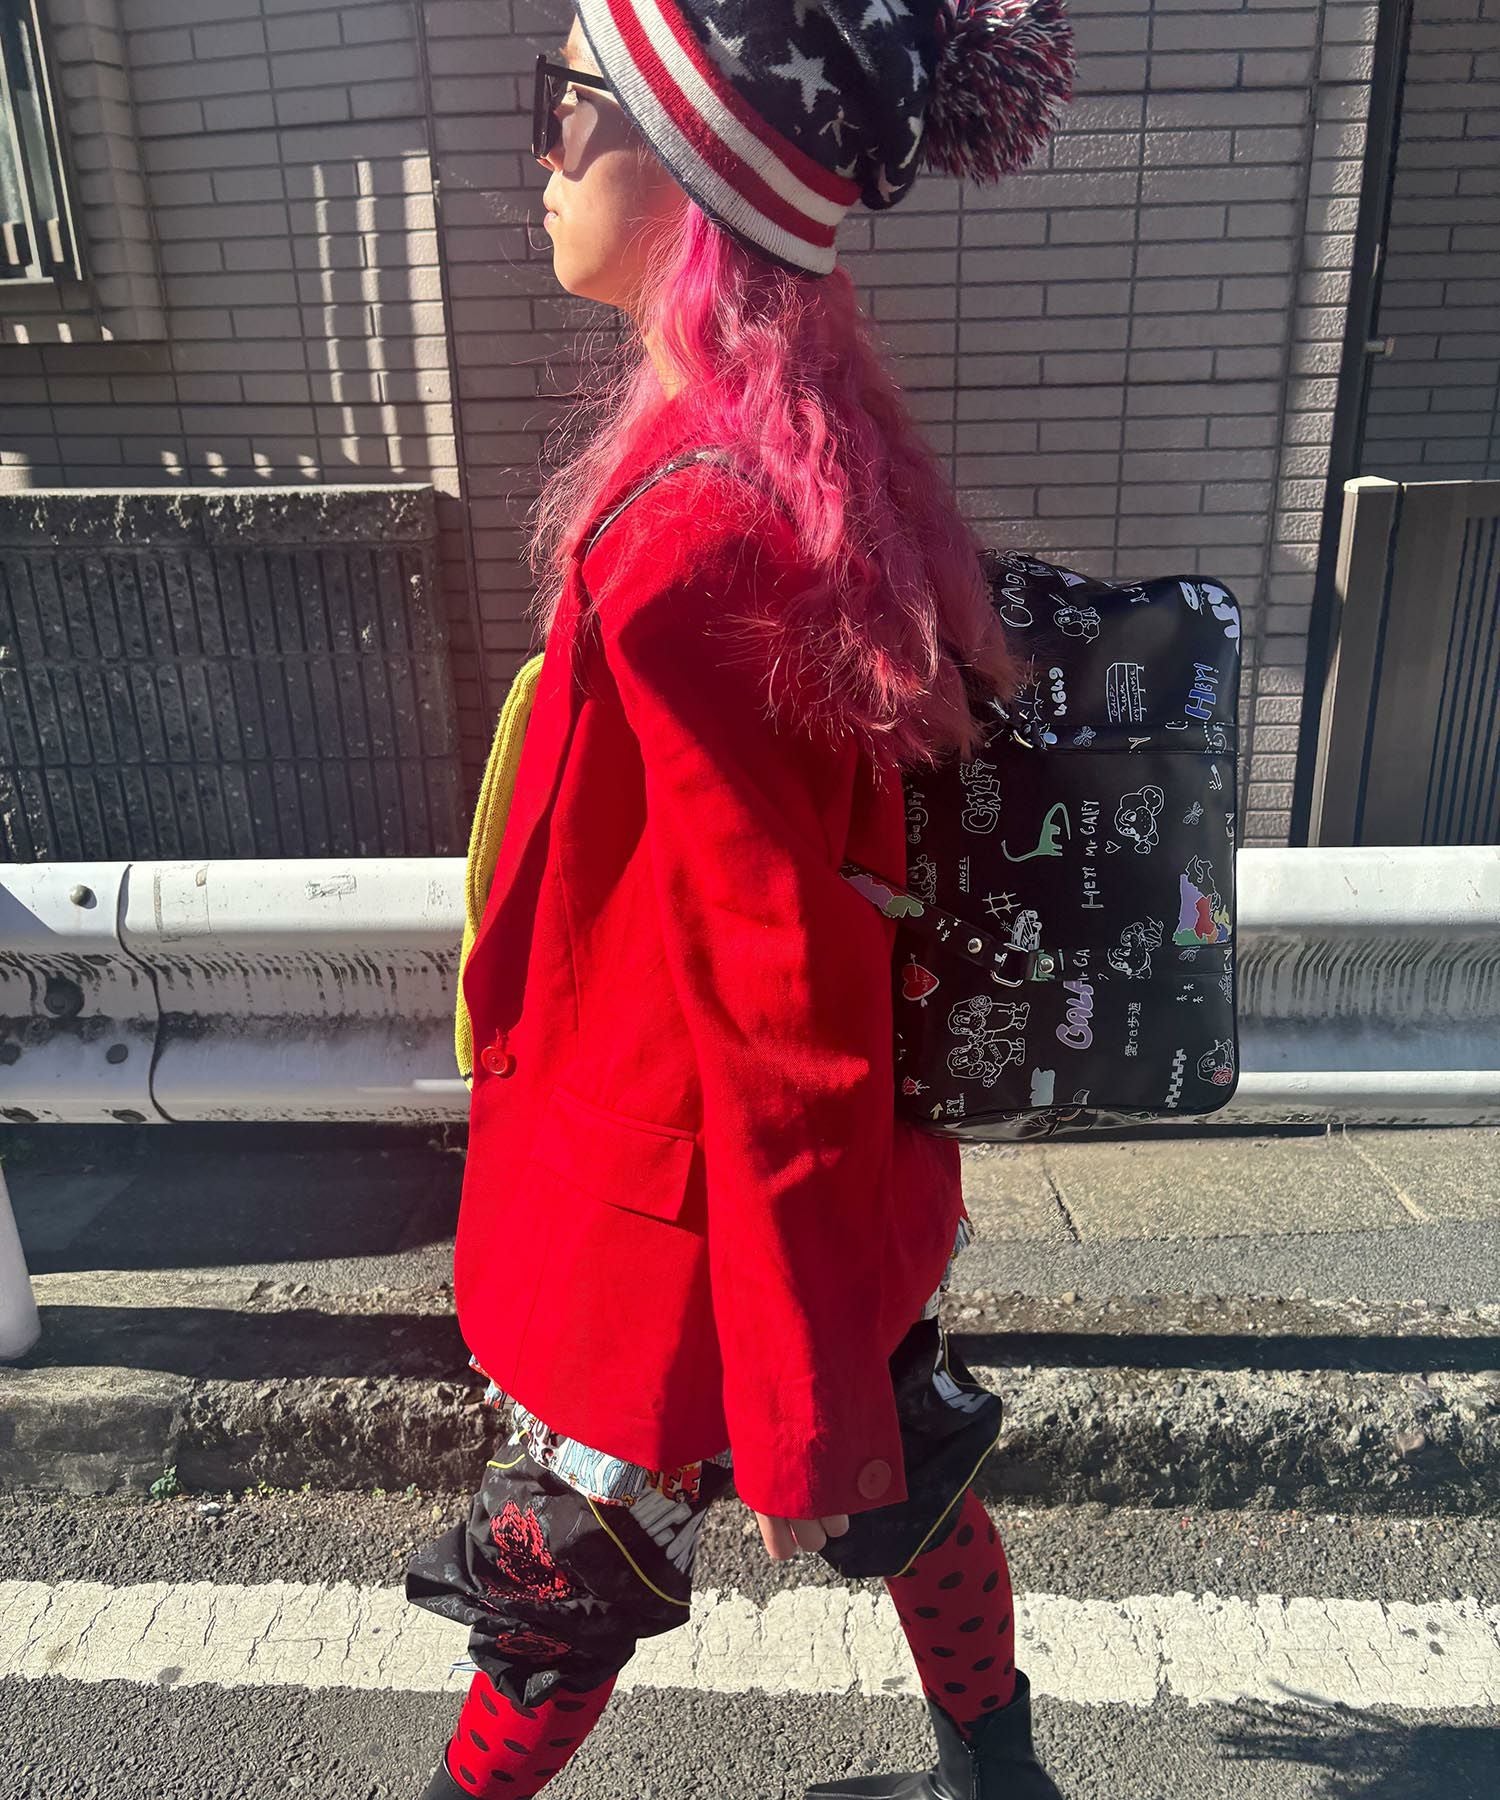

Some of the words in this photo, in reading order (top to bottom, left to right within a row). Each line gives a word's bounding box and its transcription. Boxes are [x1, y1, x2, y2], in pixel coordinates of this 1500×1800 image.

[1049, 667, 1067, 717] 4649
[959, 758, 1002, 834] GALFY
[959, 857, 967, 893] ANGEL
